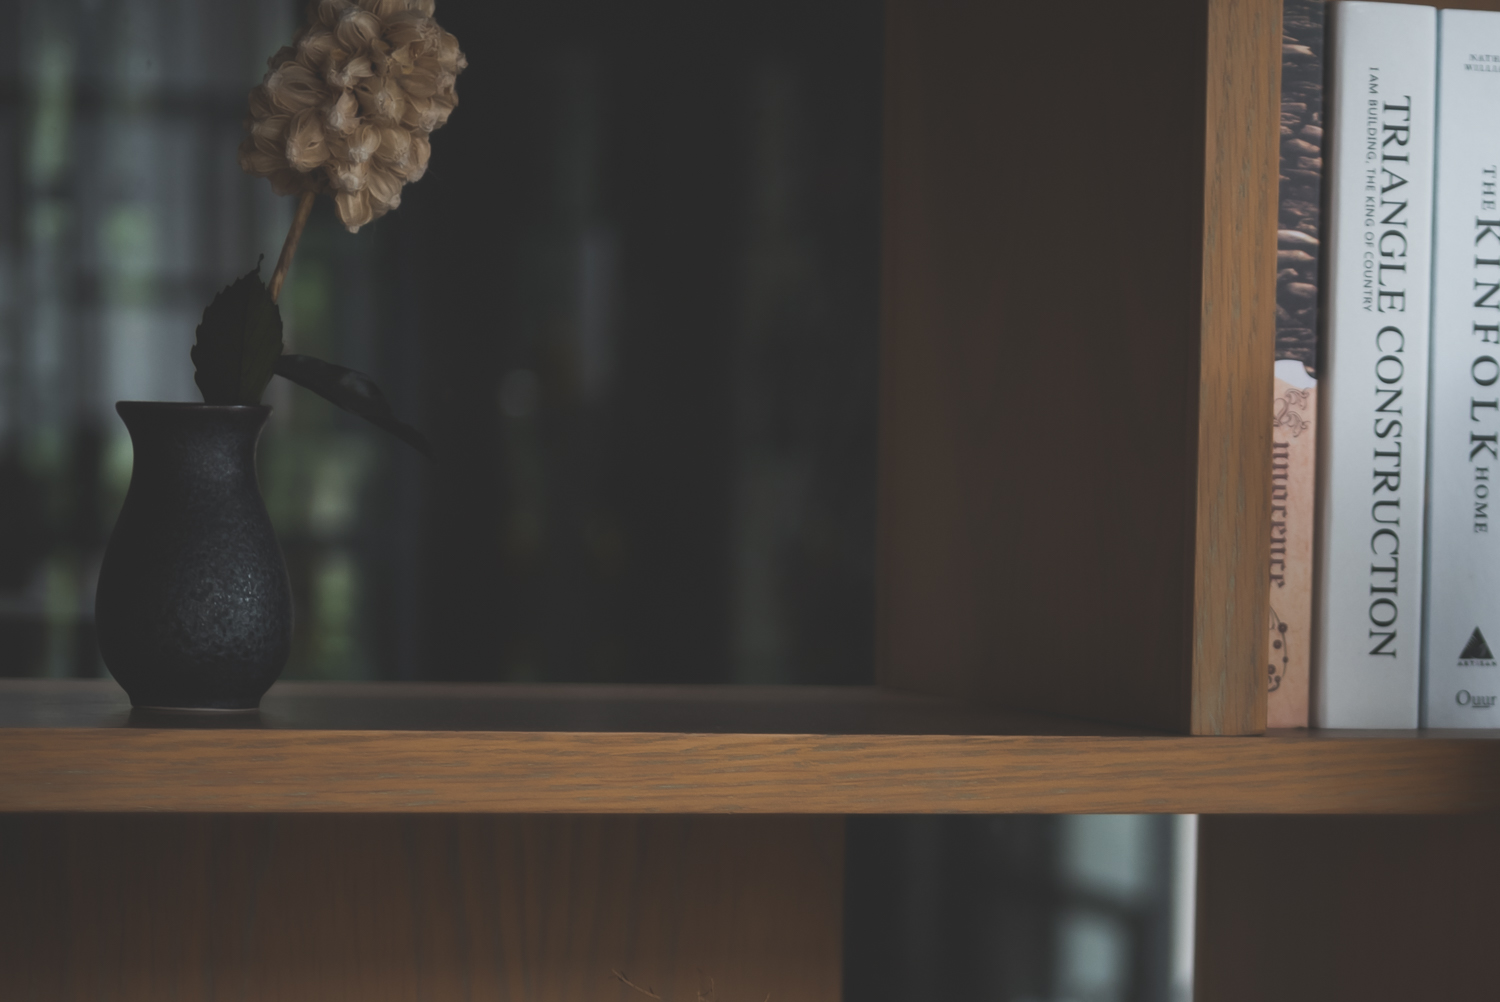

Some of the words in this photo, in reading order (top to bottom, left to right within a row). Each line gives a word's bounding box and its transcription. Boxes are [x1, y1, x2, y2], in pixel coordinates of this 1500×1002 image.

[1368, 74, 1379, 94] AM
[1365, 100, 1378, 164] BUILDING,
[1364, 168, 1377, 191] THE
[1377, 94, 1411, 313] TRIANGLE
[1480, 165, 1496, 212] THE
[1364, 196, 1376, 227] KING
[1363, 232, 1375, 248] OF
[1362, 251, 1374, 312] COUNTRY
[1368, 325, 1404, 659] CONSTRUCTION
[1473, 467, 1489, 533] HOME
